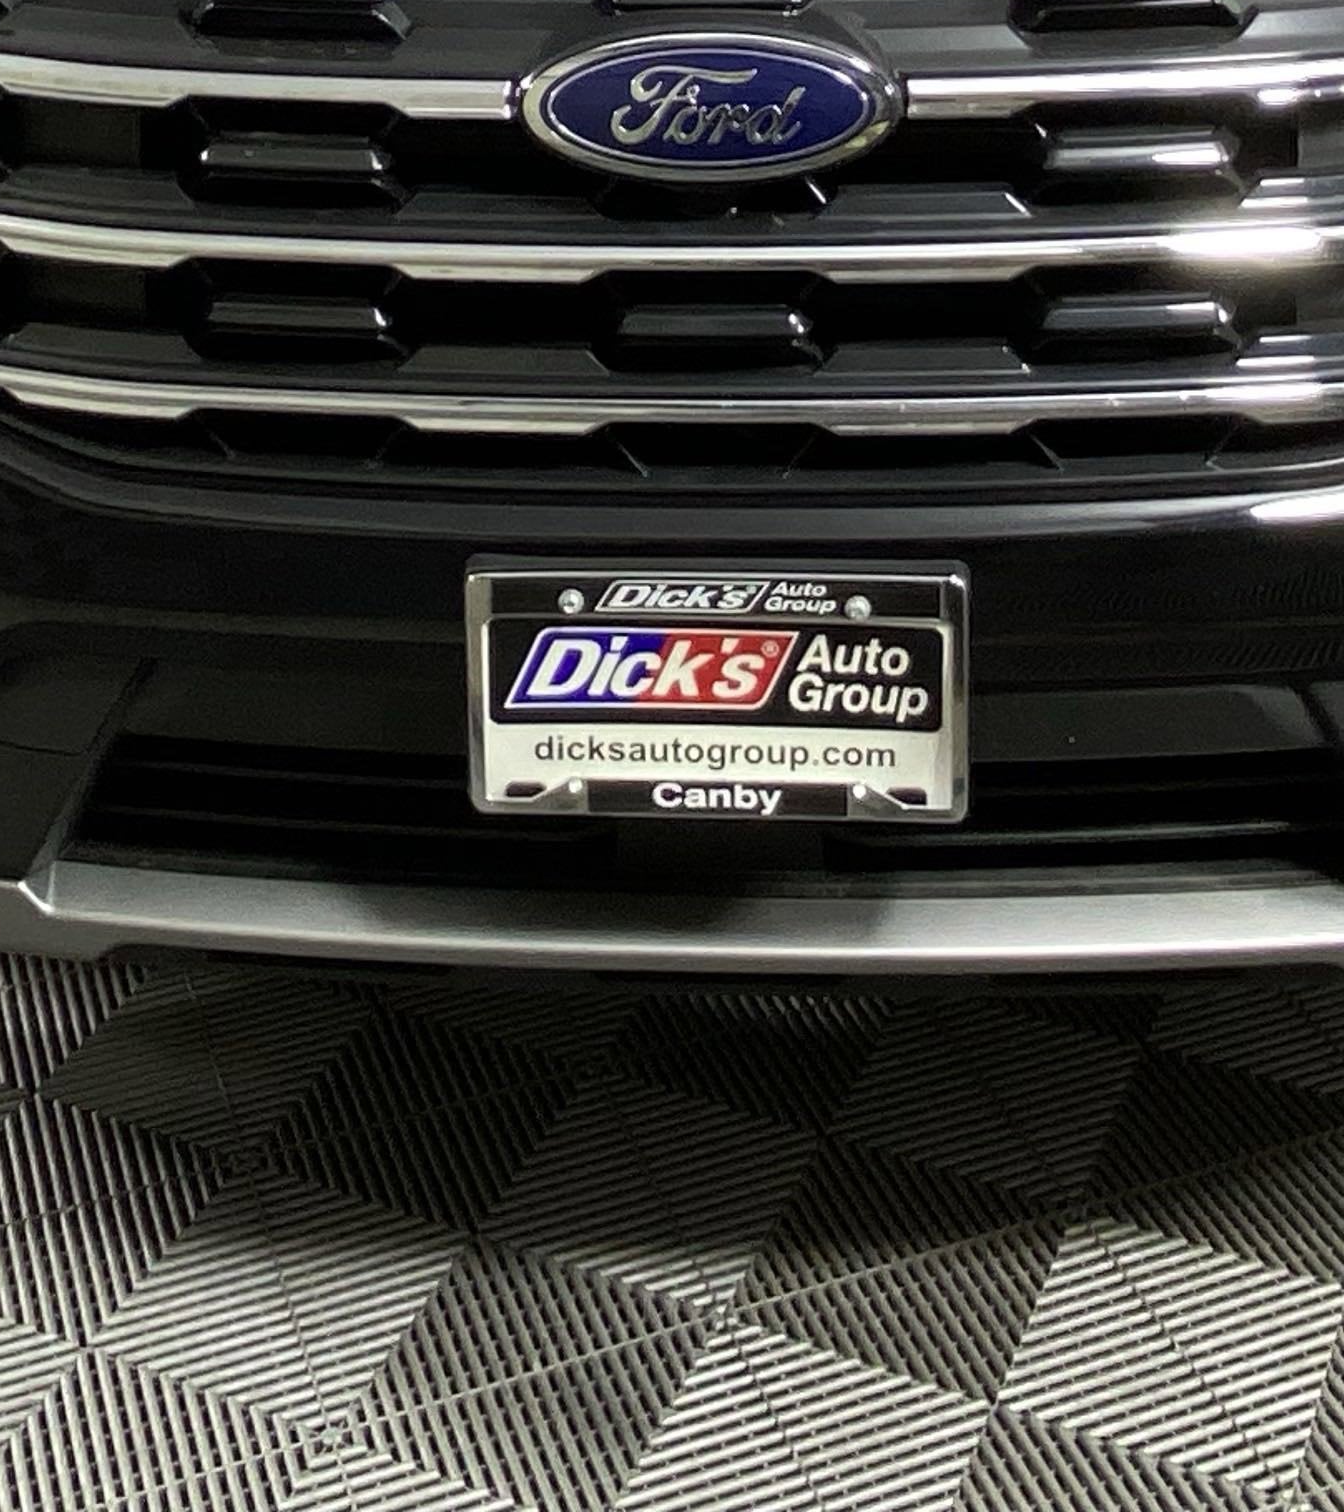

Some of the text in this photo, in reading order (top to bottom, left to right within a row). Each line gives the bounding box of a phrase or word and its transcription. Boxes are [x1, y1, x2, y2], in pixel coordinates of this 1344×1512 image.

[610, 64, 806, 145] Ford
[606, 583, 749, 609] Dick's
[763, 595, 837, 614] Group
[770, 581, 828, 597] Auto
[795, 633, 910, 677] Auto
[787, 671, 930, 724] Group
[533, 735, 897, 772] dicksautogroup.com
[651, 782, 783, 816] Canby
